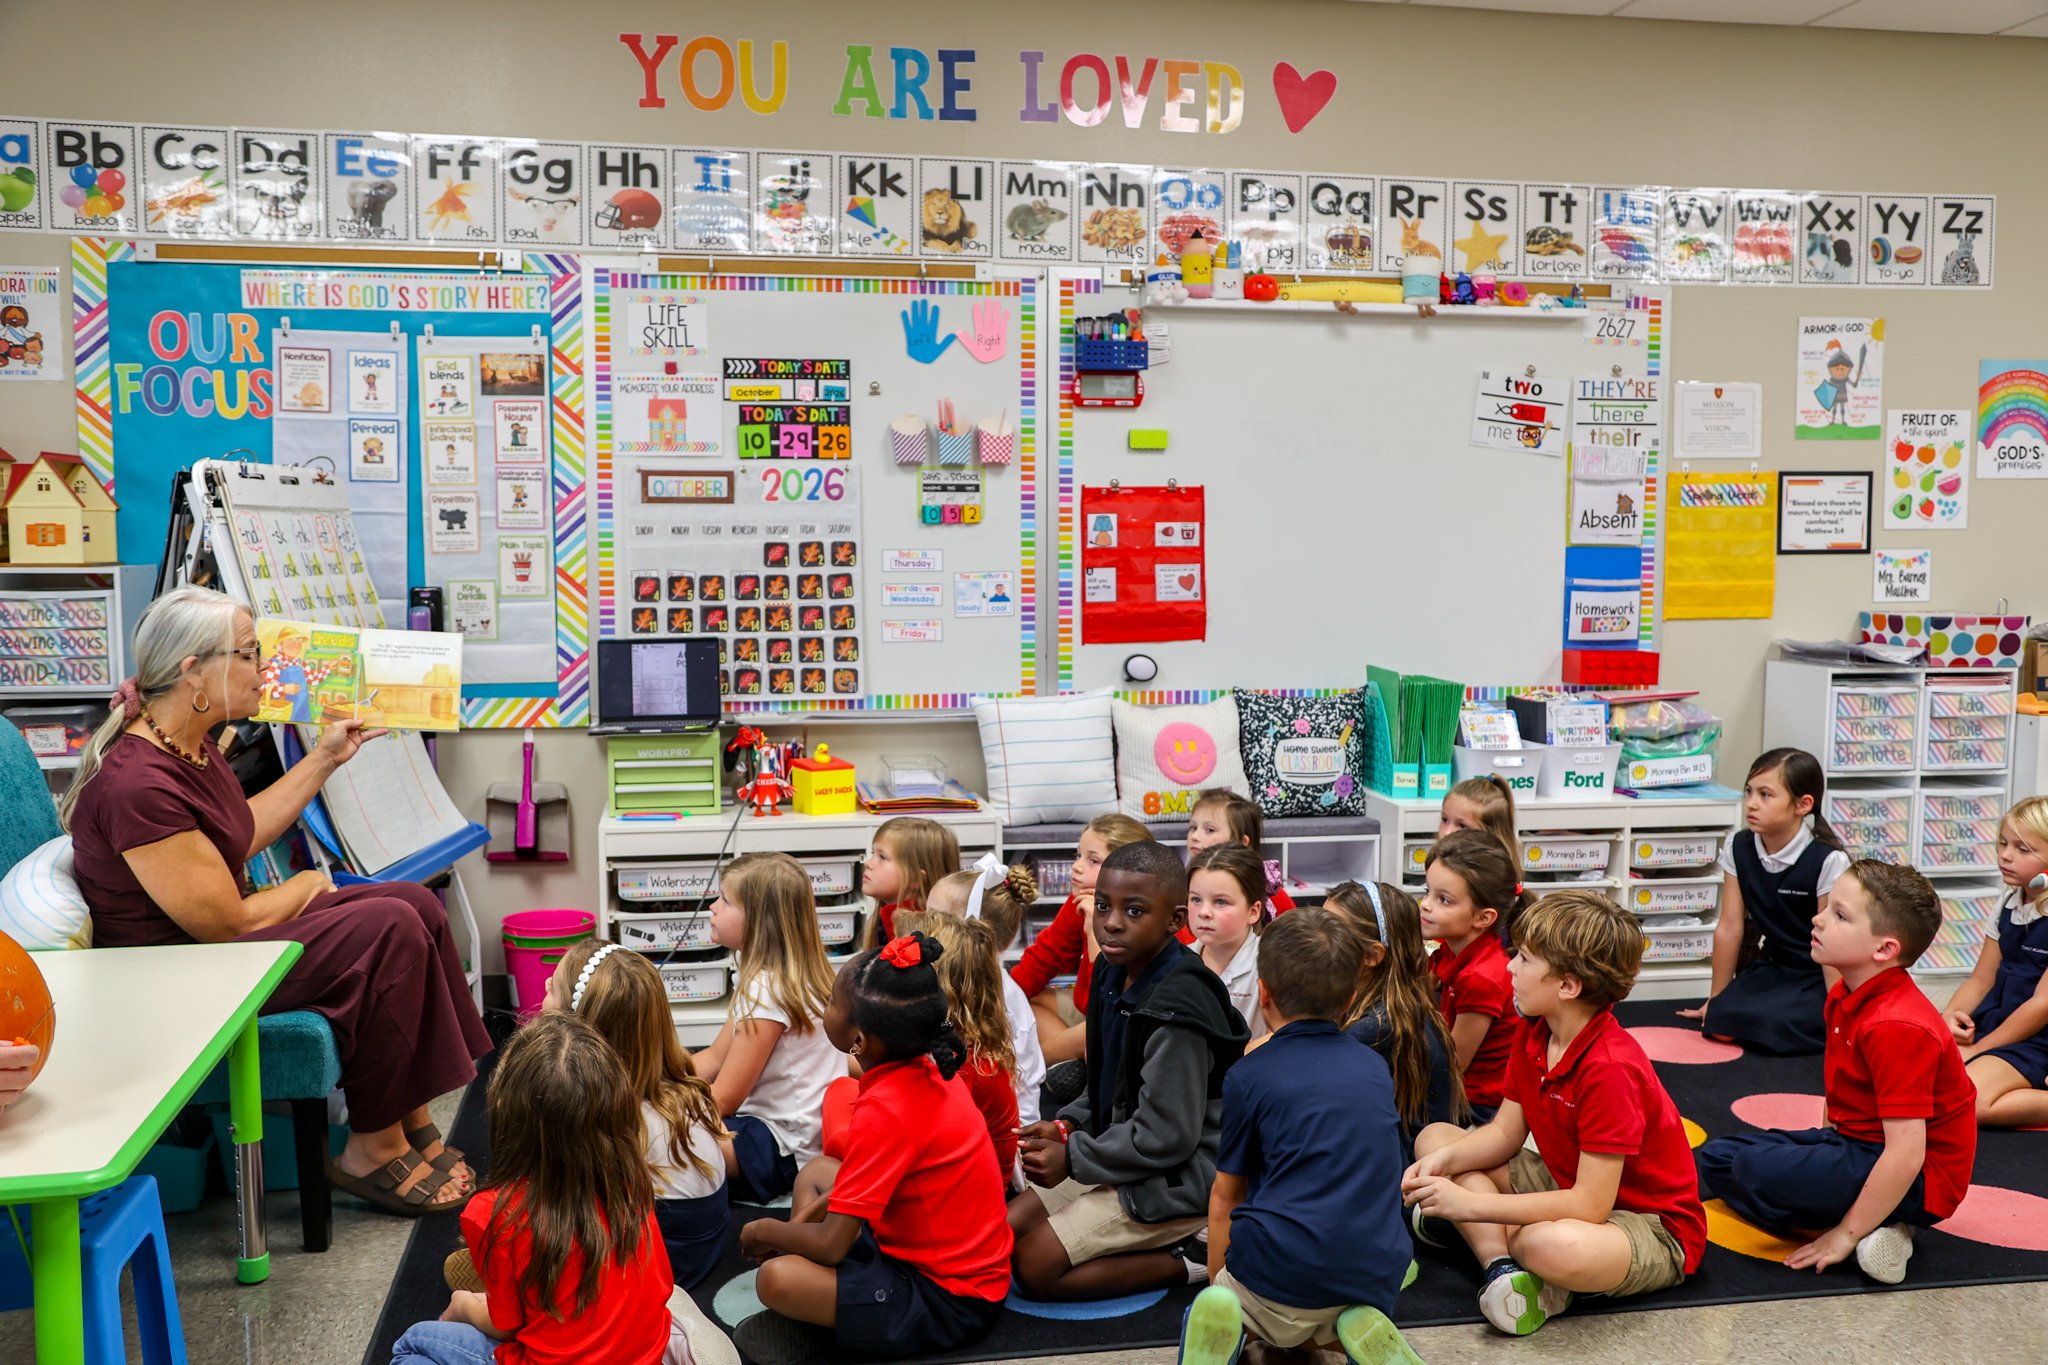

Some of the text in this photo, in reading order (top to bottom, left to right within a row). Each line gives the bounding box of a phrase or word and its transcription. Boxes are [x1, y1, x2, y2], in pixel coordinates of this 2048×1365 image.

[620, 34, 1244, 133] YOU ARE LOVED
[56, 130, 125, 168] Bb
[155, 133, 220, 170] Cc
[243, 138, 308, 175] Dd
[336, 139, 399, 177] Ee
[428, 144, 481, 180] Ff
[509, 150, 573, 194] Gg
[600, 150, 659, 188] Hh
[694, 156, 732, 193] Ii
[849, 161, 907, 197] Kk
[950, 165, 983, 201] Ll
[1006, 172, 1067, 198] Mm
[1085, 173, 1145, 208] Nn
[1161, 177, 1225, 210] Oo
[1240, 178, 1295, 221] Pp
[1311, 183, 1371, 223] Qq
[1389, 185, 1440, 219] Rr
[1464, 188, 1507, 221] Ss
[1538, 191, 1578, 223] Tt
[1602, 193, 1652, 225] Uu
[1668, 197, 1723, 228] Vv
[1737, 198, 1792, 223] Ww
[1805, 200, 1856, 232] Xx
[1875, 203, 1921, 241] Yy
[1942, 203, 1984, 234] Zz
[466, 224, 489, 238] fish
[962, 235, 988, 252] lion
[1018, 243, 1067, 256] mouse
[1267, 246, 1294, 264] pig
[1157, 272, 1176, 282] GLUE
[246, 282, 548, 310] WHERE IS GOD'S STORY HERE?
[648, 304, 688, 327] LIFE
[1596, 316, 1636, 338] 2627
[1803, 324, 1837, 334] ARMOR
[1845, 322, 1864, 332] GOD
[149, 310, 265, 364] OUR
[643, 326, 694, 349] SKILL
[909, 333, 931, 347] Left
[977, 333, 1001, 351] Right
[284, 352, 326, 362] Nonfiction
[354, 356, 391, 369] Ideas
[436, 361, 457, 371] End
[758, 360, 846, 374] TODAY'S DATE
[429, 370, 465, 380] blends
[114, 363, 273, 420] FOCUS
[619, 383, 715, 394] MEMORIZE YOUR ADDRESS
[736, 388, 774, 397] October
[1505, 376, 1542, 396] two
[503, 412, 533, 422] Nouns
[742, 406, 847, 423] TODAY'S DATE
[1592, 401, 1645, 422] there
[1902, 413, 1957, 426] FRUIT OF
[351, 422, 395, 434] Reread
[1705, 424, 1731, 432] VISION
[1909, 427, 1948, 438] the spirit
[744, 431, 847, 451] 10 29 26
[1590, 427, 1642, 447] their
[1998, 445, 2041, 460] GOD'S
[1998, 460, 2042, 473] promises
[922, 472, 941, 481] DAYS
[950, 472, 980, 482] SCHOOL
[653, 479, 723, 497] OCTOBER
[762, 467, 846, 502] 2026
[949, 508, 957, 520] 5
[968, 506, 977, 520] 2
[1579, 508, 1639, 529] Absent
[500, 541, 544, 551] Main Topic
[894, 559, 932, 569] Thursday
[462, 584, 480, 593] Key
[844, 586, 853, 597] 10
[890, 594, 935, 604] Wednesday
[58, 608, 101, 622] BOOKS
[991, 604, 1007, 612] cool
[1575, 601, 1635, 616] Homework
[649, 621, 657, 632] 11
[682, 621, 692, 632] 12
[718, 620, 728, 631] 13
[751, 620, 760, 631] 14
[779, 619, 790, 630] 15
[814, 618, 824, 630] 16
[845, 618, 854, 630] 17
[900, 628, 927, 639] Friday
[60, 637, 103, 650] BOOKS
[749, 651, 759, 662] 21
[780, 651, 791, 662] 22
[812, 650, 823, 662] 23
[847, 650, 857, 661] 24
[1, 661, 102, 684] BAND-AIDS
[748, 682, 760, 693] 28
[782, 681, 794, 693] 29
[813, 681, 825, 693] 30
[1958, 699, 1984, 713] Ada
[1556, 726, 1600, 736] WRITING
[1850, 721, 1898, 740] Marley
[1948, 720, 1983, 738] Louie
[637, 748, 691, 758] WORKPRO
[1836, 744, 1907, 765] Charlotte
[1281, 754, 1343, 772] CLASSROOM
[1651, 762, 1706, 777] Morning Bin #13
[1396, 775, 1416, 784] Barnes
[1430, 777, 1445, 786] Ford
[1563, 770, 1605, 788] Ford
[1850, 800, 1889, 819] Sadie
[1844, 823, 1889, 843] Briggs
[1943, 822, 1976, 841] Luka
[1546, 849, 1600, 860] Morning Bin #4
[1656, 844, 1707, 856] Morning Bin #1
[650, 875, 712, 889] Watercolors
[1656, 890, 1709, 901] Morning Bin #2
[659, 919, 705, 934] Whiteboard
[1655, 938, 1708, 949] Morning Bin #3
[661, 972, 697, 984] Wonders
[669, 983, 690, 993] Tools
